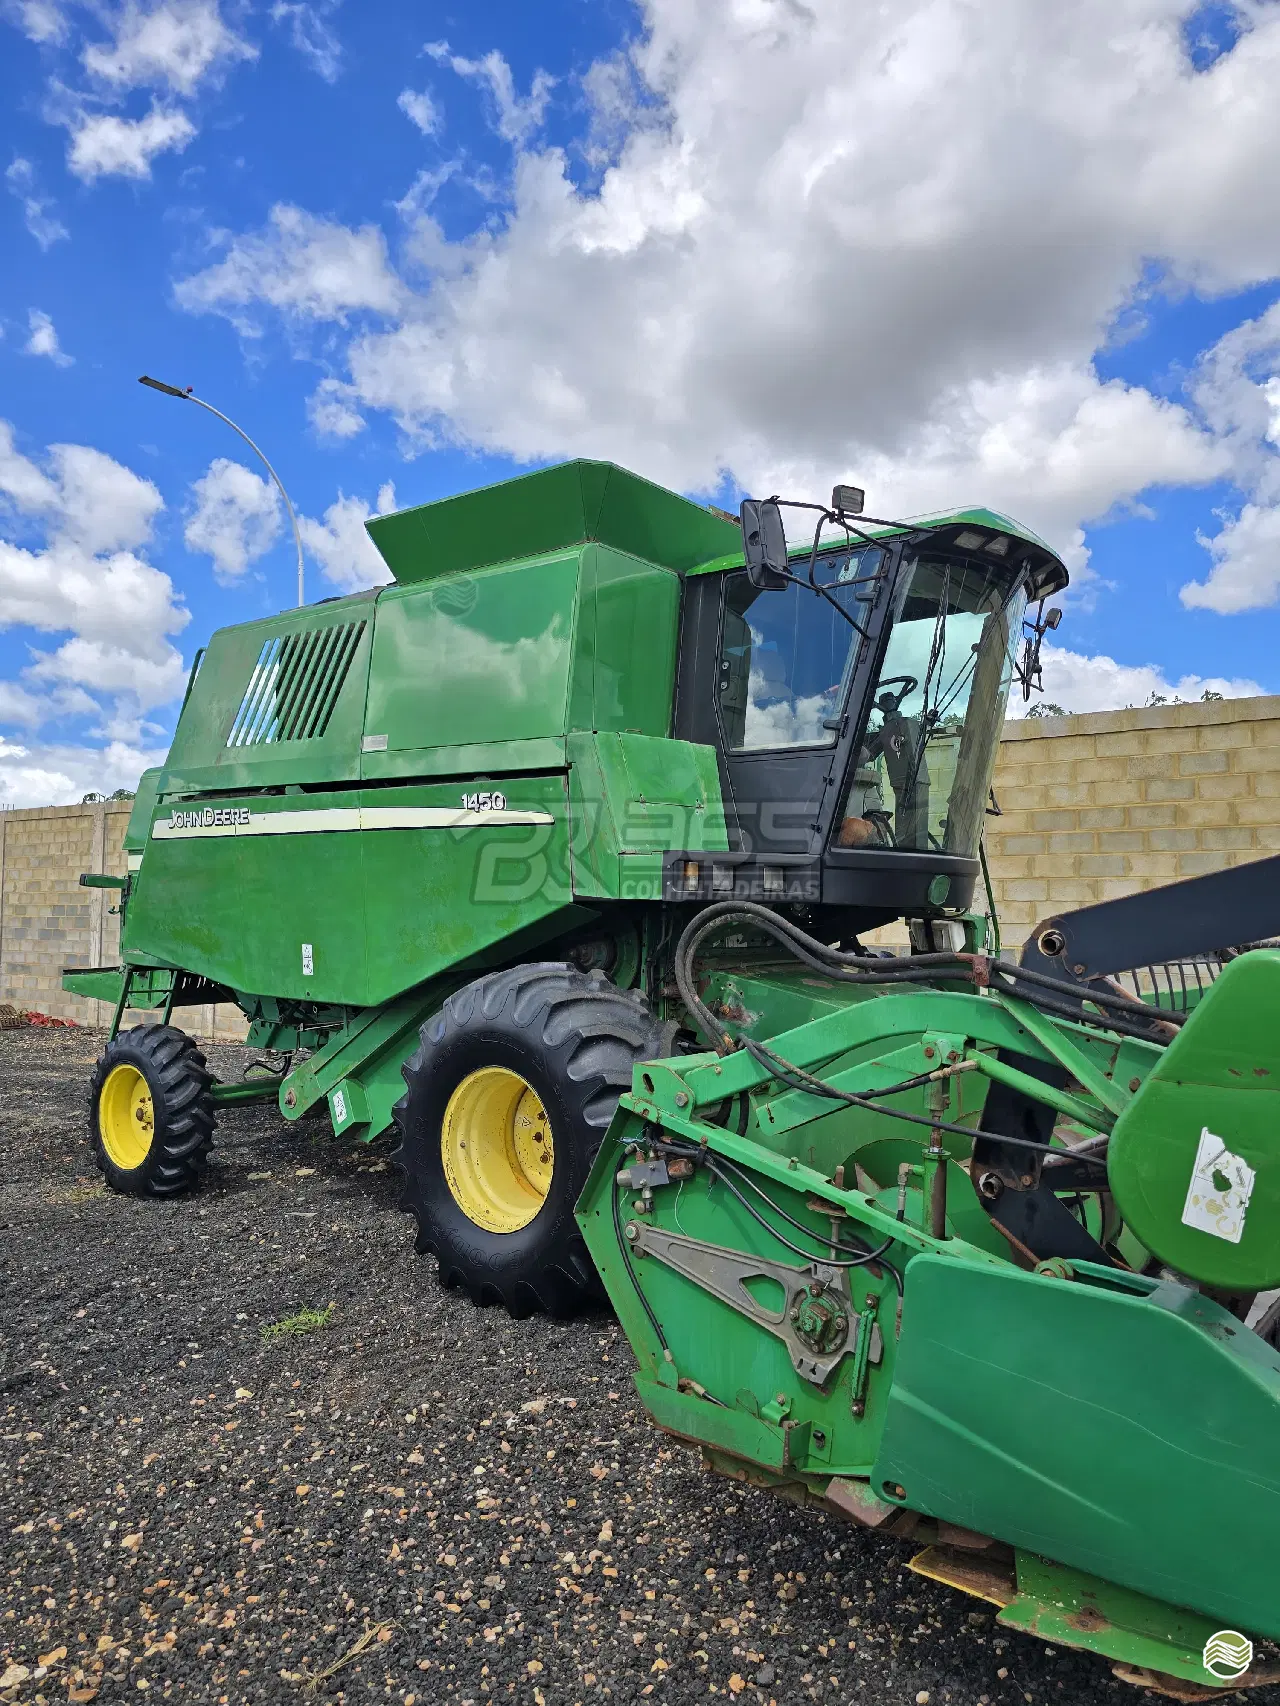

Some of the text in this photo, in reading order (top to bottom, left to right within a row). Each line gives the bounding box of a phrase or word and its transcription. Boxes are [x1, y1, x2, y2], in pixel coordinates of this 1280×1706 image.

[461, 791, 507, 813] 1450
[168, 807, 250, 829] JOHN DEERE
